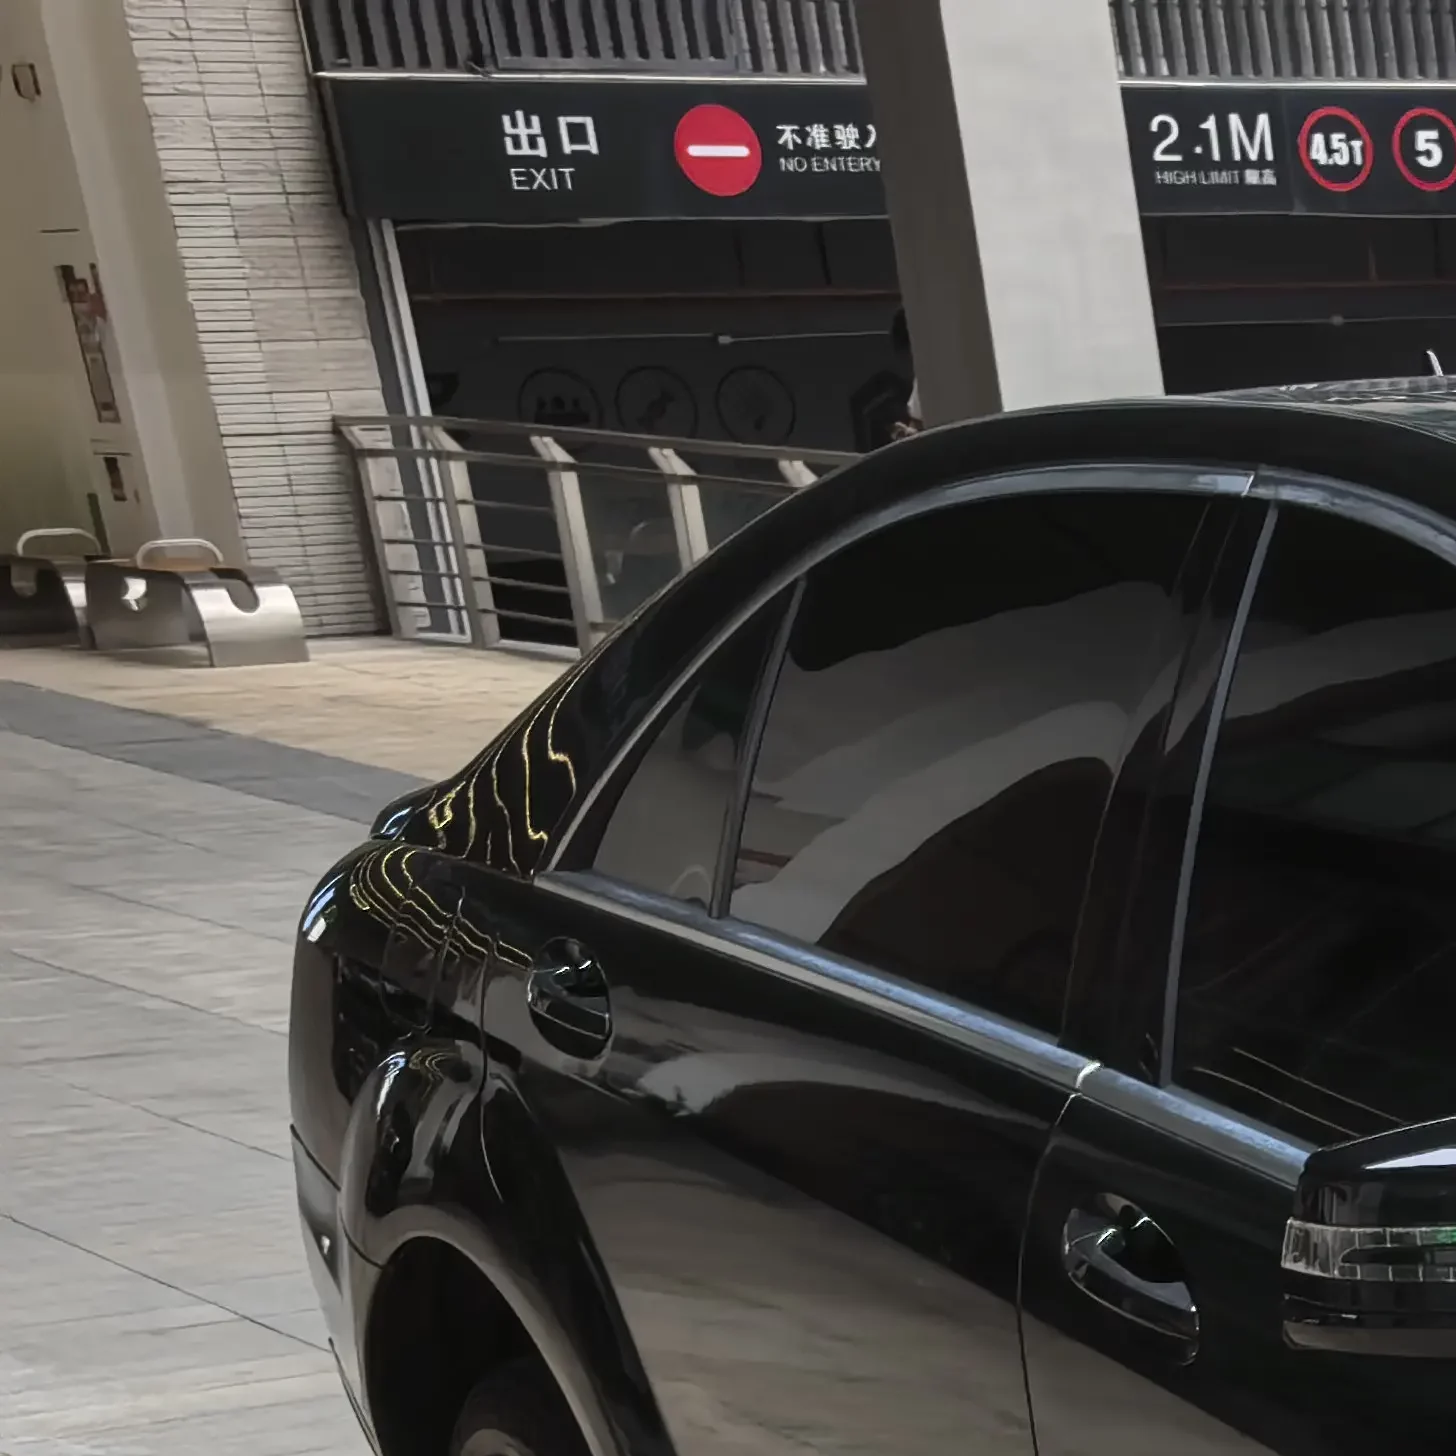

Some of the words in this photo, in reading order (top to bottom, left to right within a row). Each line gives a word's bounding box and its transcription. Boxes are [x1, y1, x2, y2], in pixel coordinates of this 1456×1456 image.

[502, 109, 599, 158] 出口
[1150, 112, 1274, 162] 2.1M
[1415, 129, 1443, 168] 5
[510, 167, 575, 190] EXIT
[780, 156, 807, 172] NO
[1155, 170, 1196, 185] HIGH
